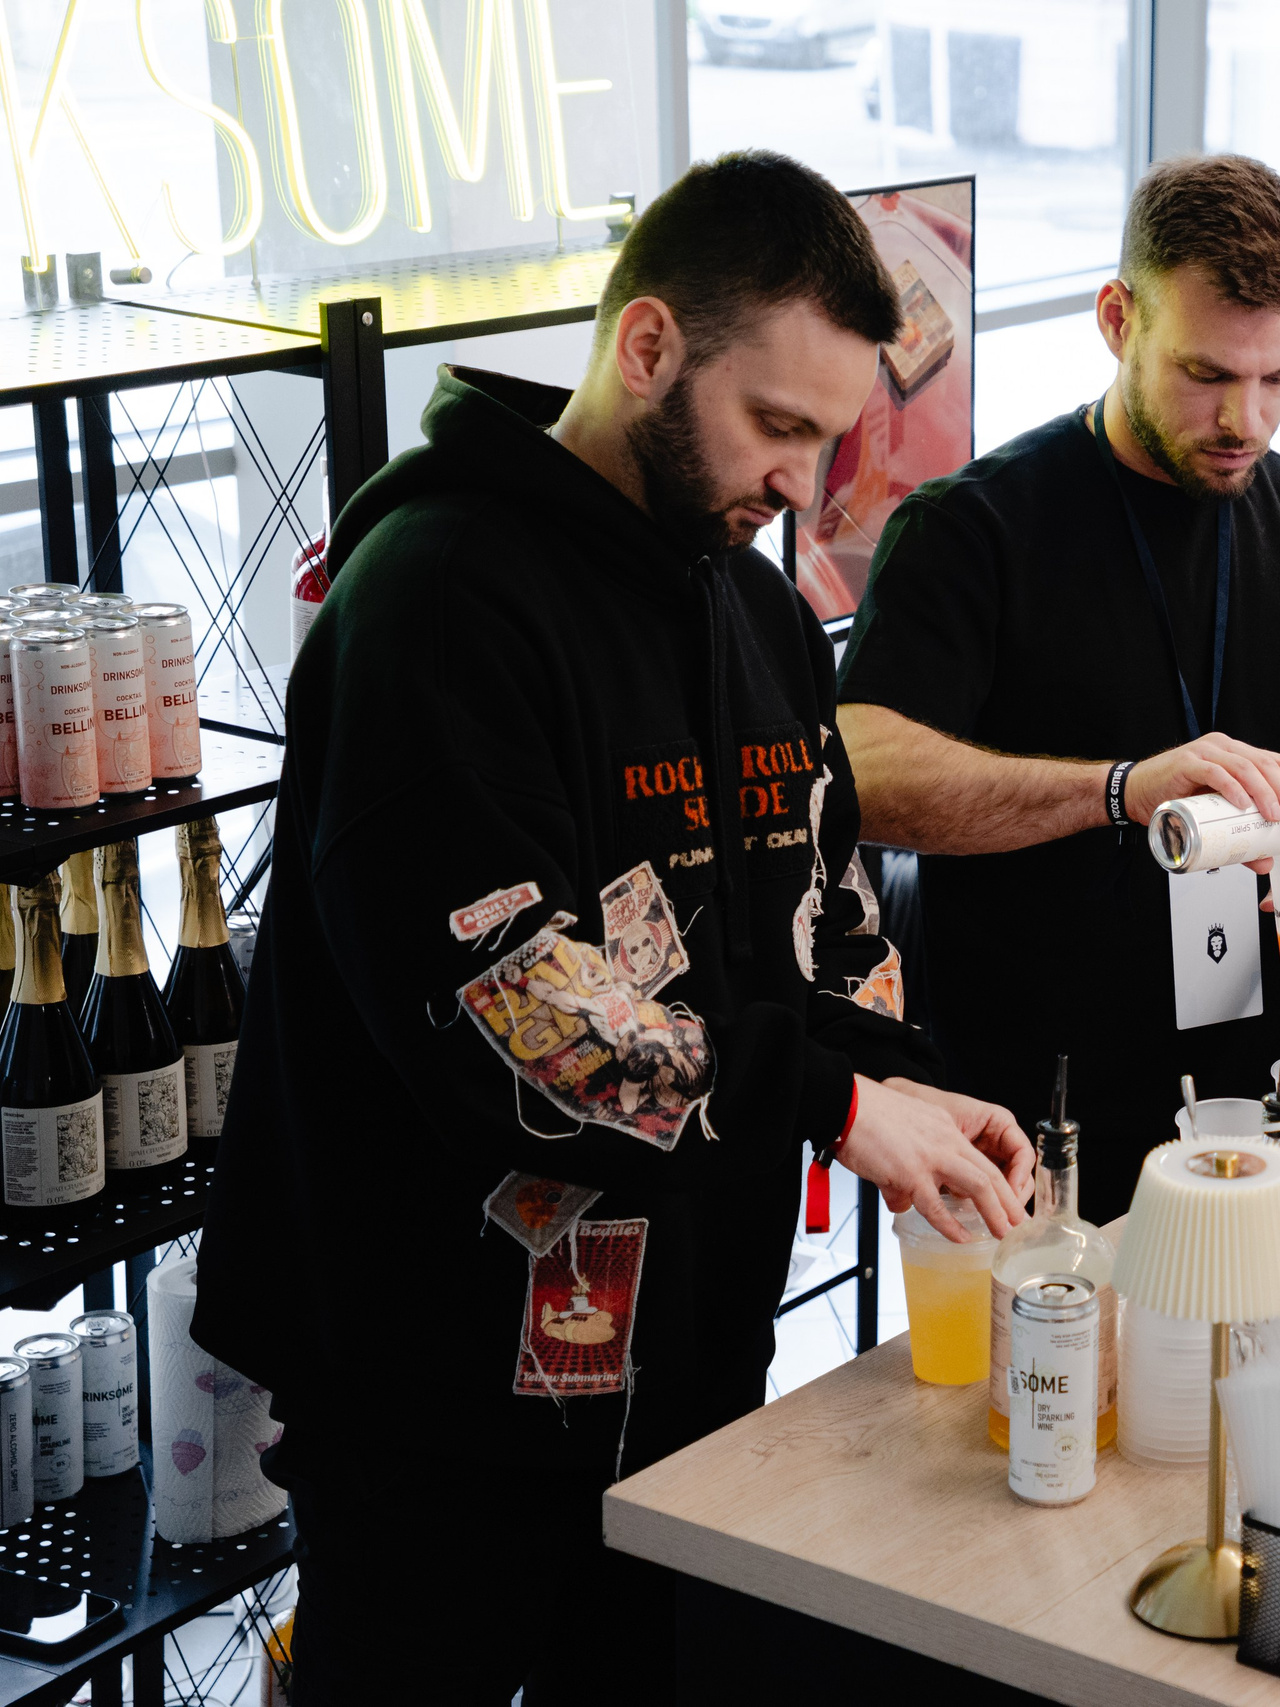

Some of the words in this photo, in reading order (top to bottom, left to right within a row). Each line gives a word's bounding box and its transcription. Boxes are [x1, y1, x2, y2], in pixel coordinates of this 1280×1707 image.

[116, 692, 142, 702] COCKTAIL
[64, 706, 90, 716] COCKTAIL
[740, 739, 814, 778] ROLL
[463, 892, 521, 926] ADULTS
[475, 902, 516, 928] ONLY
[560, 1372, 620, 1384] Submarine
[1037, 1403, 1051, 1413] DRY
[1037, 1411, 1075, 1422] SPARKLING
[1037, 1422, 1054, 1432] WINE
